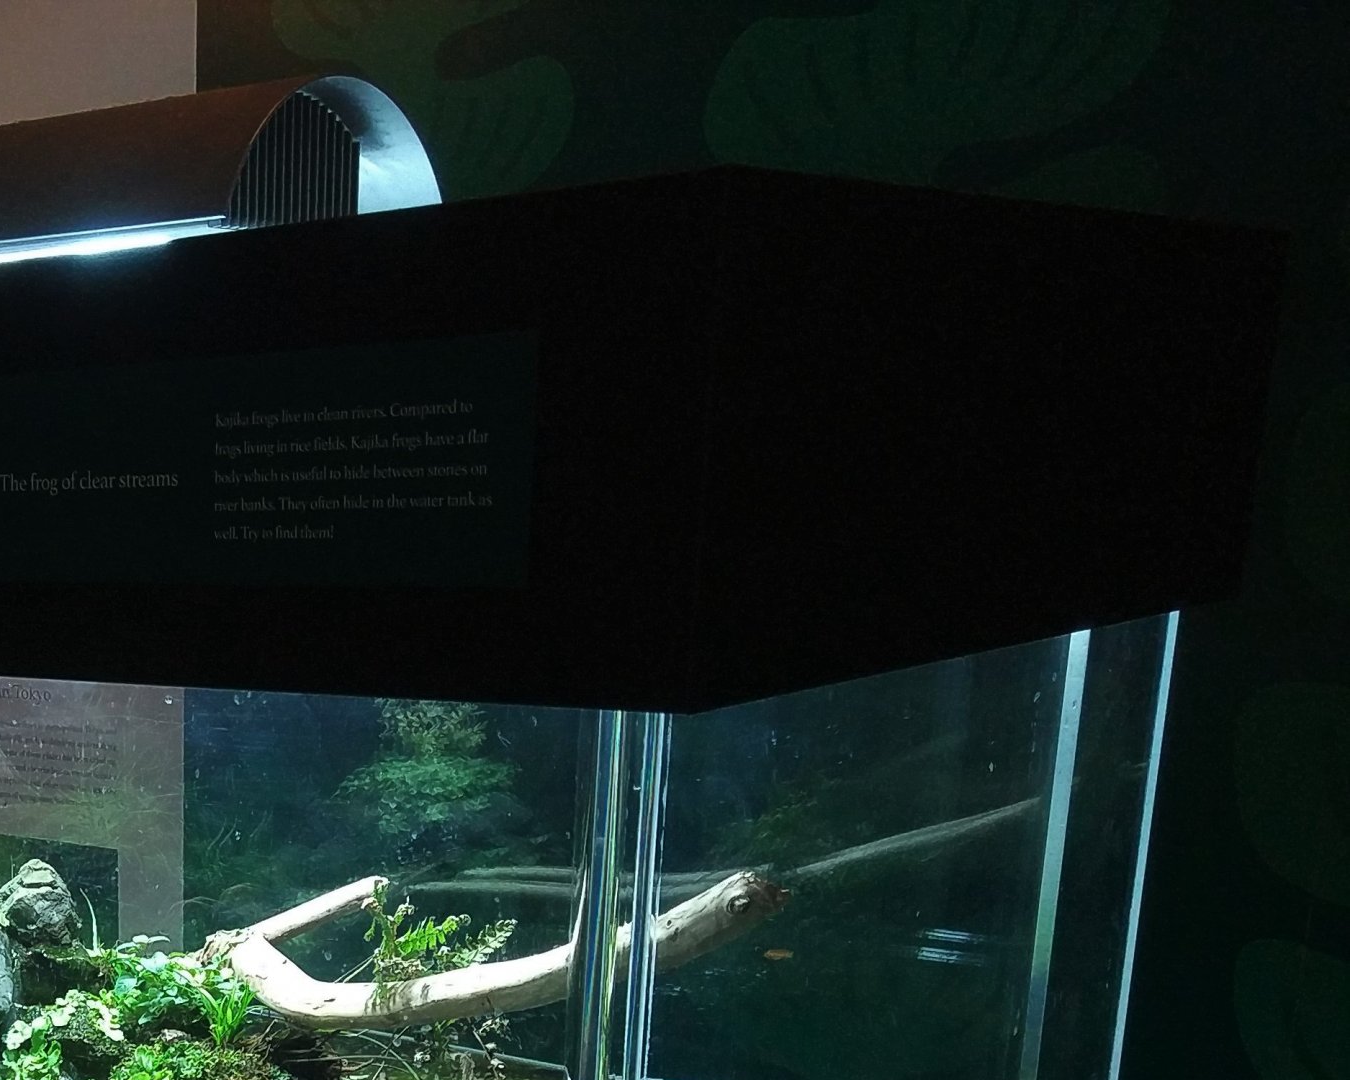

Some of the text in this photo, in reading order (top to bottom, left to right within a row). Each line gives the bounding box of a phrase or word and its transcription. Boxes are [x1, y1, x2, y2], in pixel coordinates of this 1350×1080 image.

[215, 411, 250, 430] Kajika
[252, 411, 279, 430] frogs
[281, 408, 302, 424] live
[304, 410, 315, 423] in
[317, 406, 348, 422] clean
[389, 398, 457, 420] Compared
[460, 401, 474, 414] to
[215, 440, 242, 460] frogs
[244, 439, 276, 458] living
[277, 439, 289, 453] in
[290, 439, 312, 453] rice
[351, 434, 389, 452] Kajika
[391, 432, 422, 451] frogs
[424, 431, 455, 446] have
[457, 434, 465, 445] a
[468, 428, 490, 444] flat
[0, 470, 179, 496] The frog of clear streams
[214, 463, 488, 487] body which is useful to hide between stones on
[214, 490, 493, 514] river banks. They often hide in the water tank as
[214, 523, 335, 543] well. Try to find them!
[11, 684, 53, 706] Tokyo
